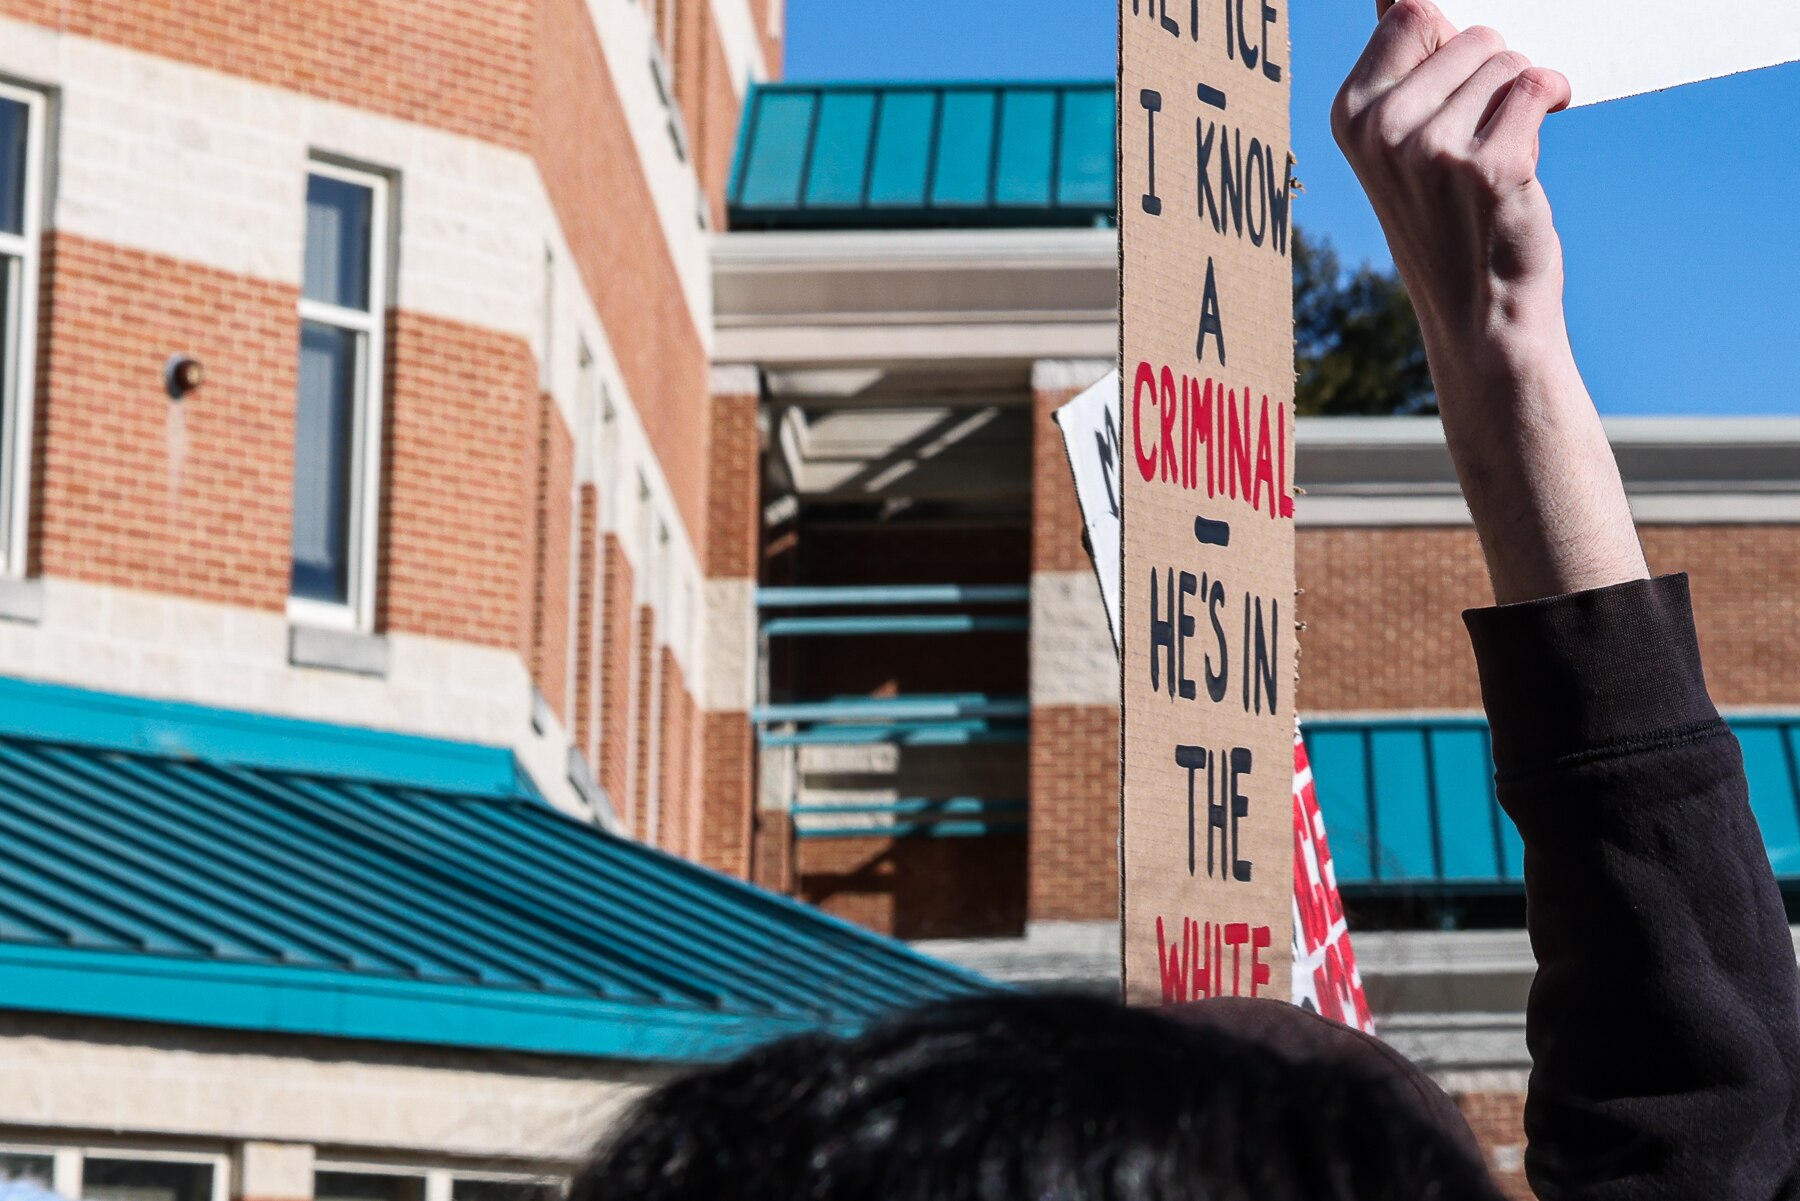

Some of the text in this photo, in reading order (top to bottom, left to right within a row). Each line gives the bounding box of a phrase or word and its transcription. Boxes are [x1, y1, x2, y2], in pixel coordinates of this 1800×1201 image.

[1140, 88, 1292, 256] I KNOW
[1196, 256, 1226, 367] A
[1132, 361, 1293, 520] CRIMINAL
[1150, 564, 1278, 716] HE'S IN
[1175, 744, 1253, 883] THE
[1156, 915, 1272, 1004] WHITE
